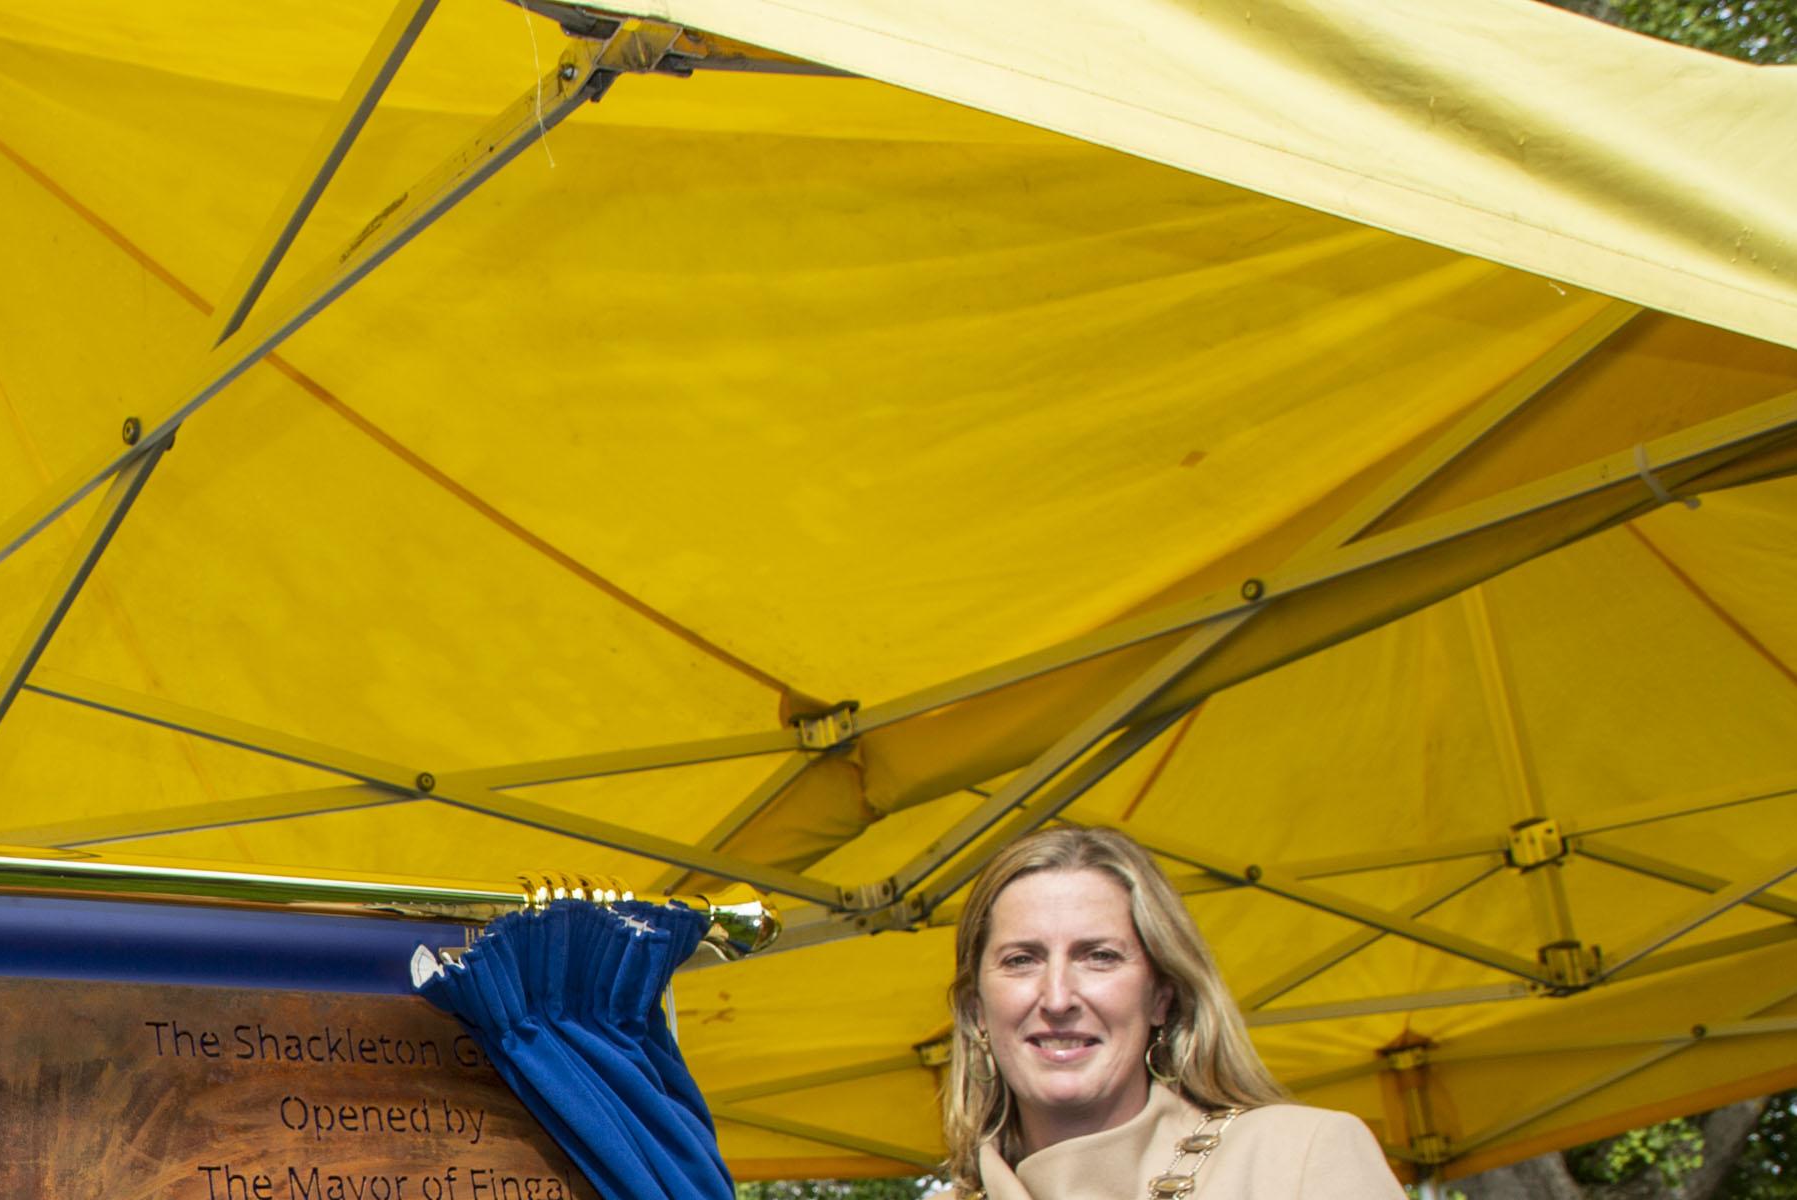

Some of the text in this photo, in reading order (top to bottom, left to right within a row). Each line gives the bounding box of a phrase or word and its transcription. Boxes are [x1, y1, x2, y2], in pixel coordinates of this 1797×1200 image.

[146, 1020, 220, 1060] The
[233, 1024, 442, 1069] Shackleton
[280, 1096, 485, 1144] Opened by
